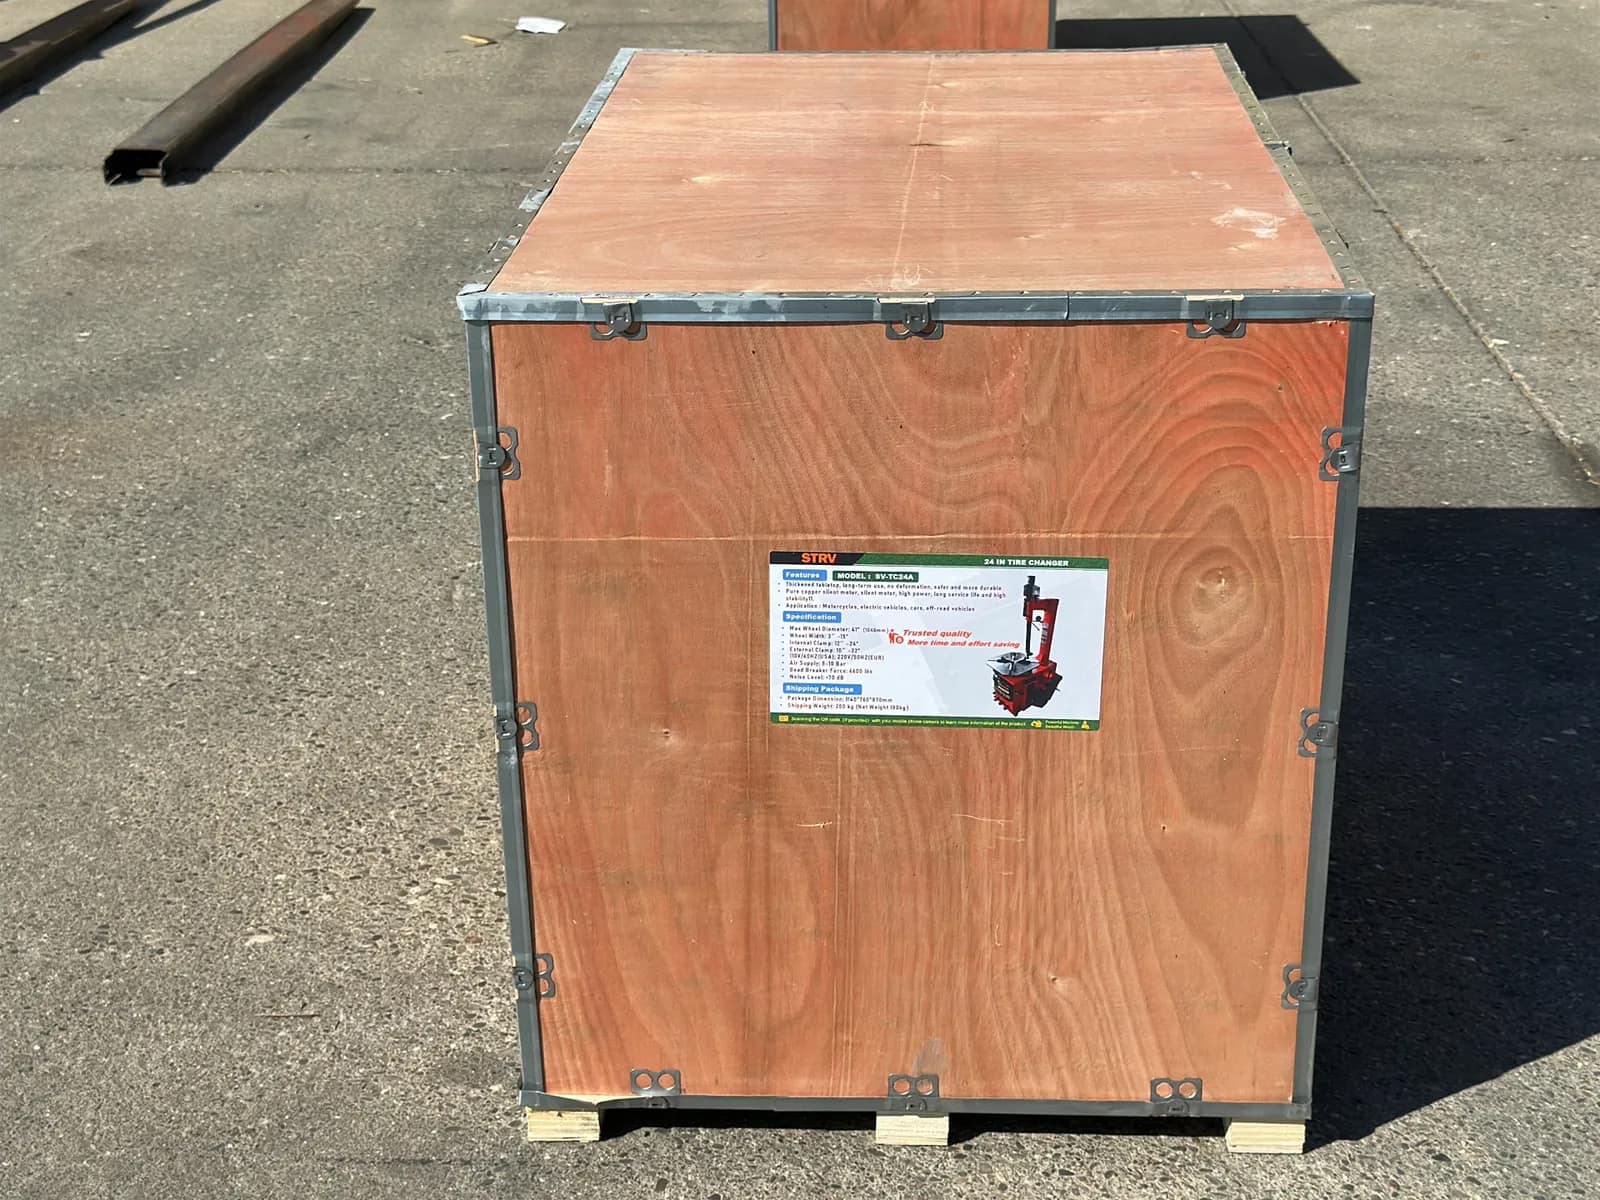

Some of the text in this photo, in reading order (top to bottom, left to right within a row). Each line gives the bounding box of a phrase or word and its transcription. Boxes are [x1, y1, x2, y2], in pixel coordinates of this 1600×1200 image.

[801, 552, 837, 564] STRV
[903, 629, 972, 639] Trusted quality
